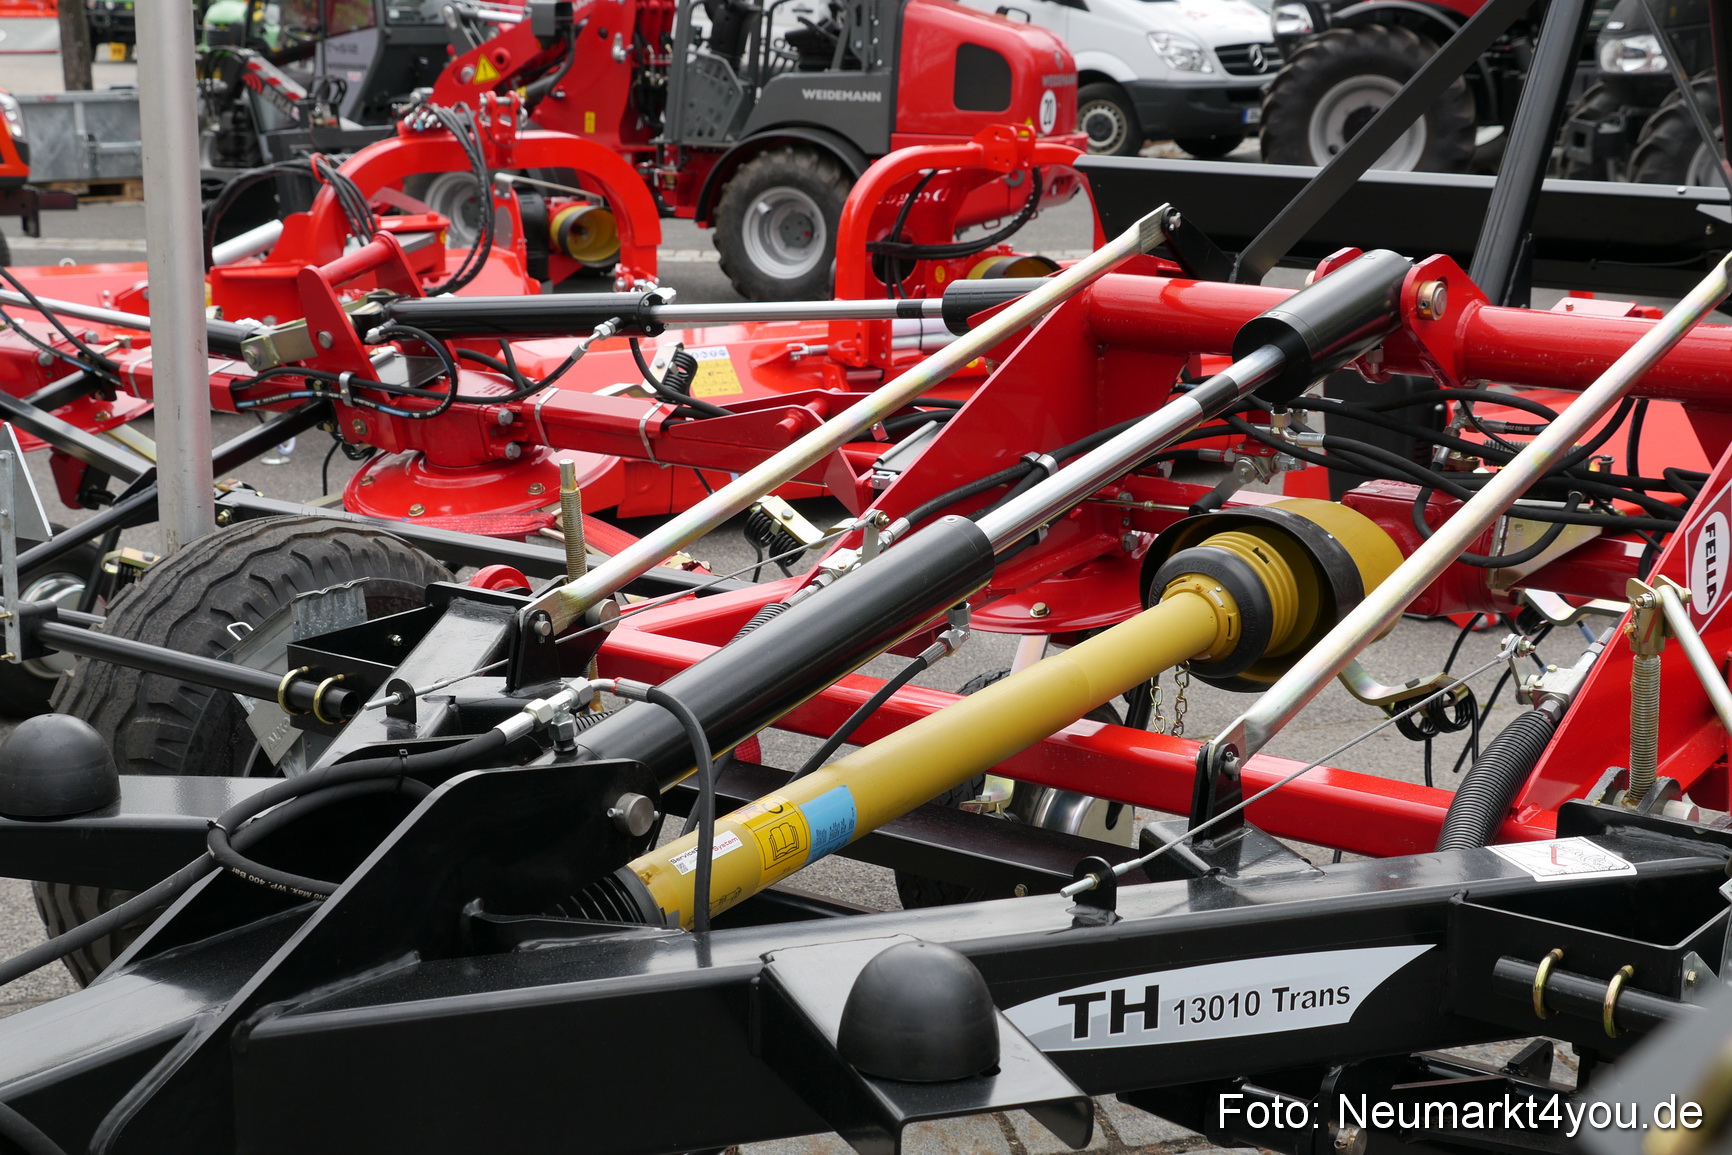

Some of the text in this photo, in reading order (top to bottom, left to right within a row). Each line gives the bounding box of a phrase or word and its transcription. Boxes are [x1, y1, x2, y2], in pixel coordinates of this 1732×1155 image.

[801, 88, 882, 102] WEIDEMANN
[1043, 98, 1053, 125] 20
[1705, 522, 1717, 609] FELLA
[231, 867, 247, 879] Bar
[248, 874, 265, 885] 400
[1058, 984, 1351, 1040] TH 13010 Trans
